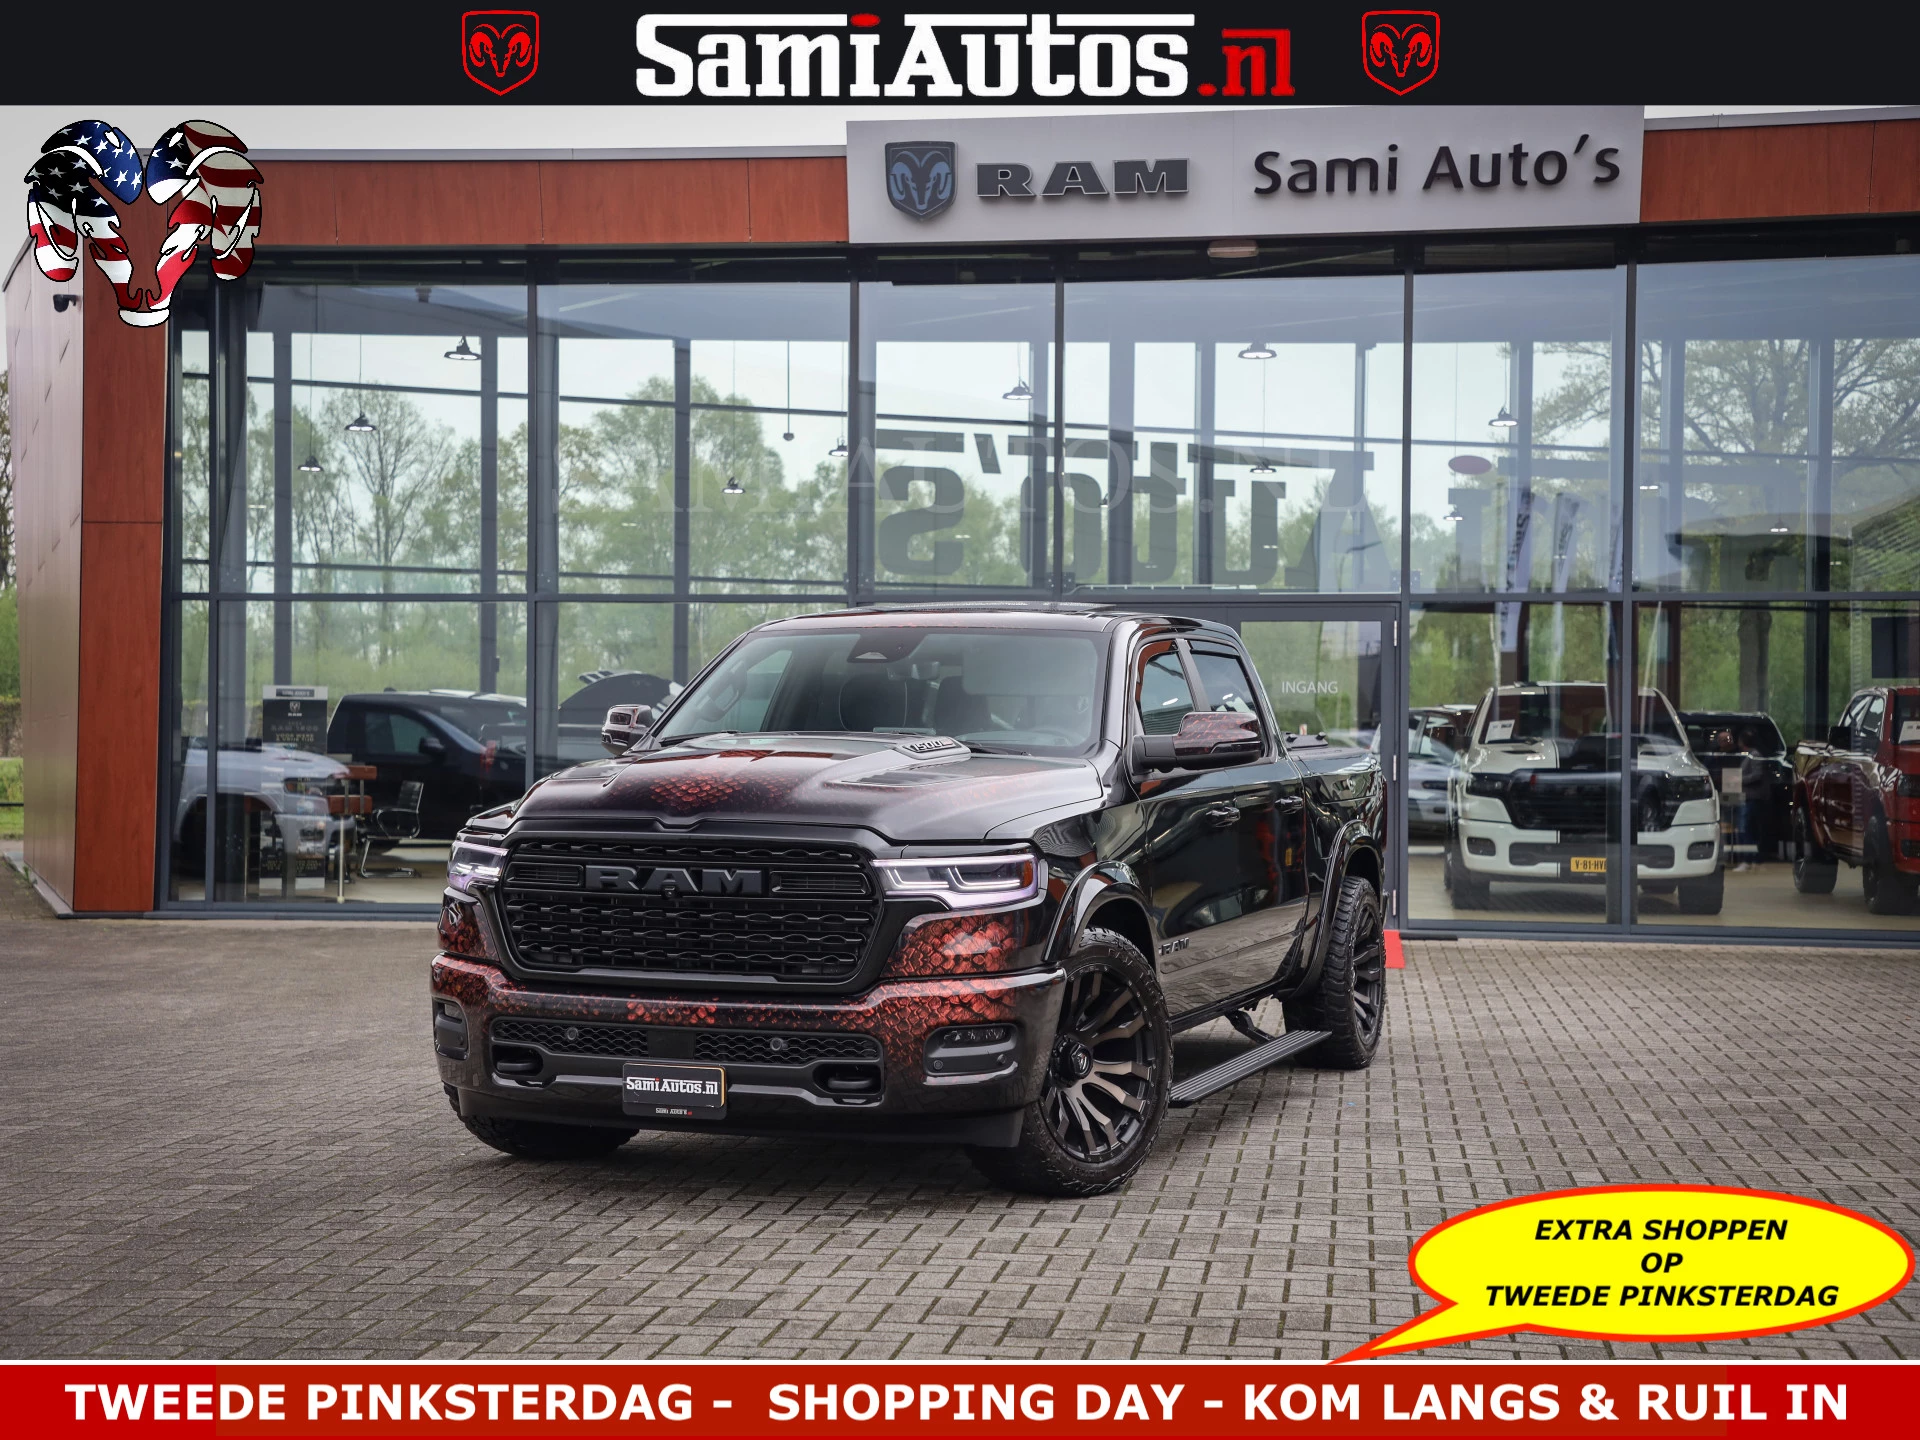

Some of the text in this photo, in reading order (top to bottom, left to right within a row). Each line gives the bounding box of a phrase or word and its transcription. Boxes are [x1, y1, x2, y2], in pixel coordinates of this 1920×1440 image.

[976, 157, 1190, 199] RAM
[1253, 133, 1622, 197] Sami Auto's
[1281, 680, 1339, 695] INGANG
[585, 864, 763, 896] RAM
[626, 1076, 719, 1096] SamiAutos.nl
